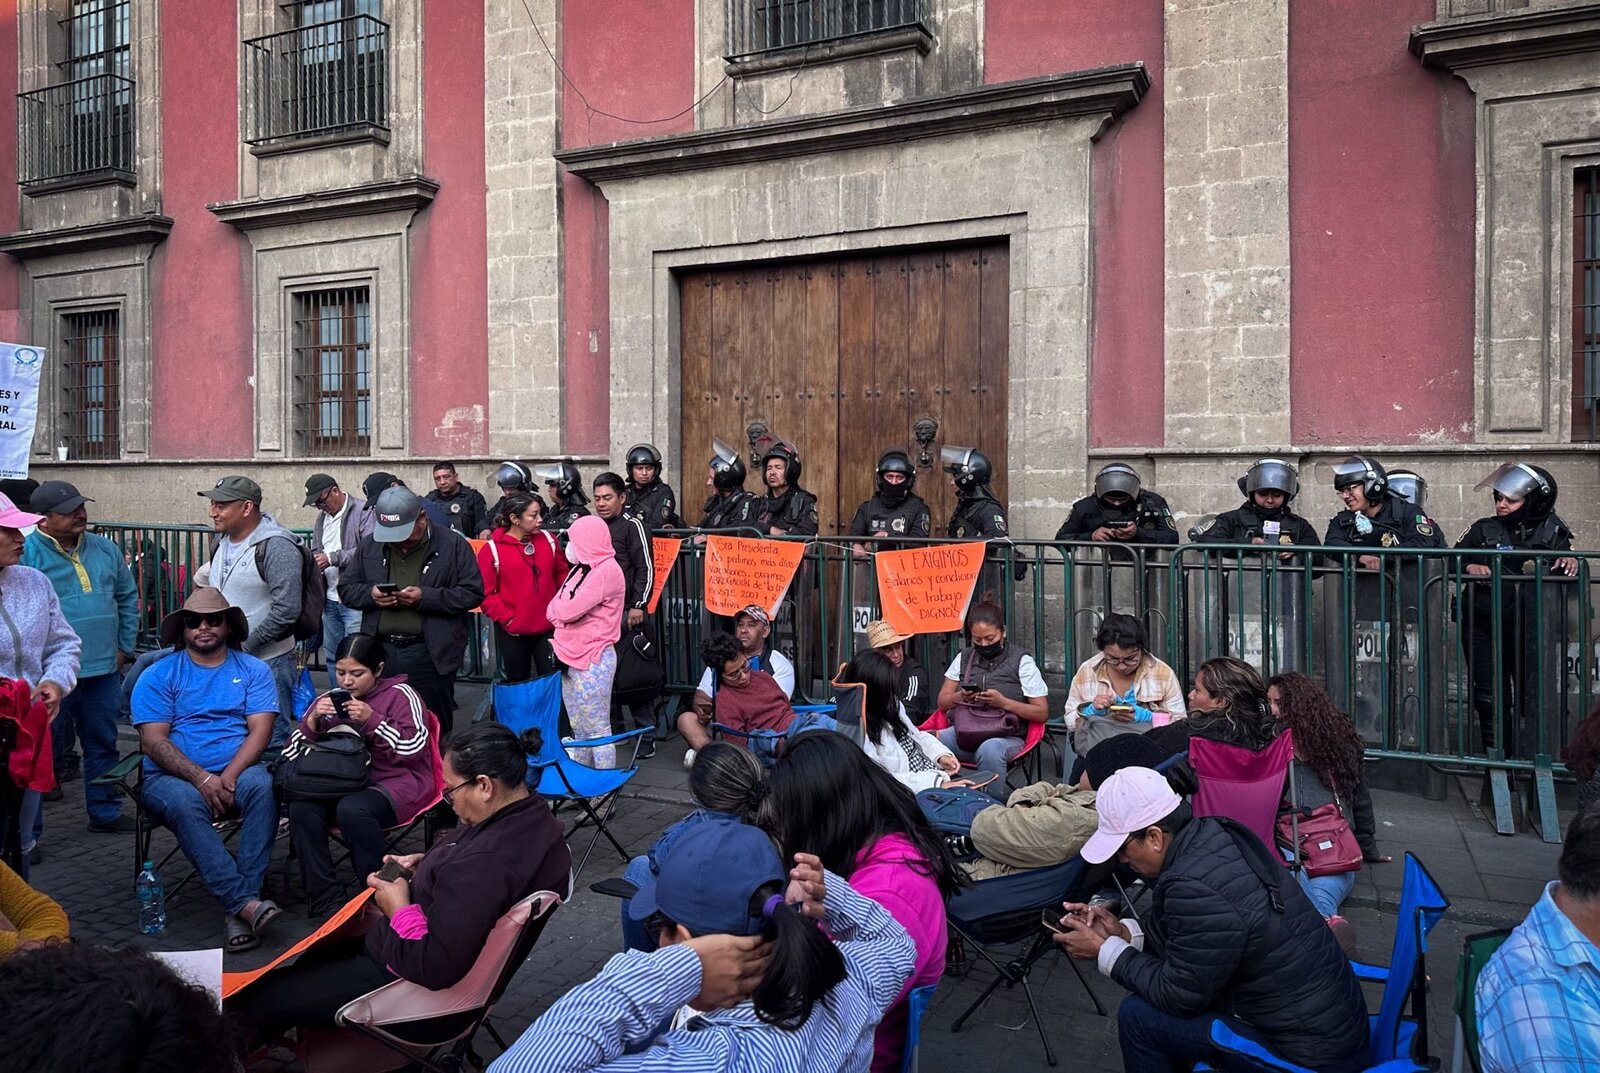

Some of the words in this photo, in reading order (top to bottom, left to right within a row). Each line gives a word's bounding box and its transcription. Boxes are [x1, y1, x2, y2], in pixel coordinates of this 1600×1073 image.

[14, 391, 20, 399] Y
[0, 405, 9, 414] R
[716, 538, 733, 551] Sra
[737, 541, 779, 554] Presidenta
[912, 549, 969, 570] EXIGIMOS
[928, 576, 933, 591] y
[905, 592, 919, 605] de
[925, 588, 962, 608] trabajo
[919, 606, 961, 620] DIGNOS
